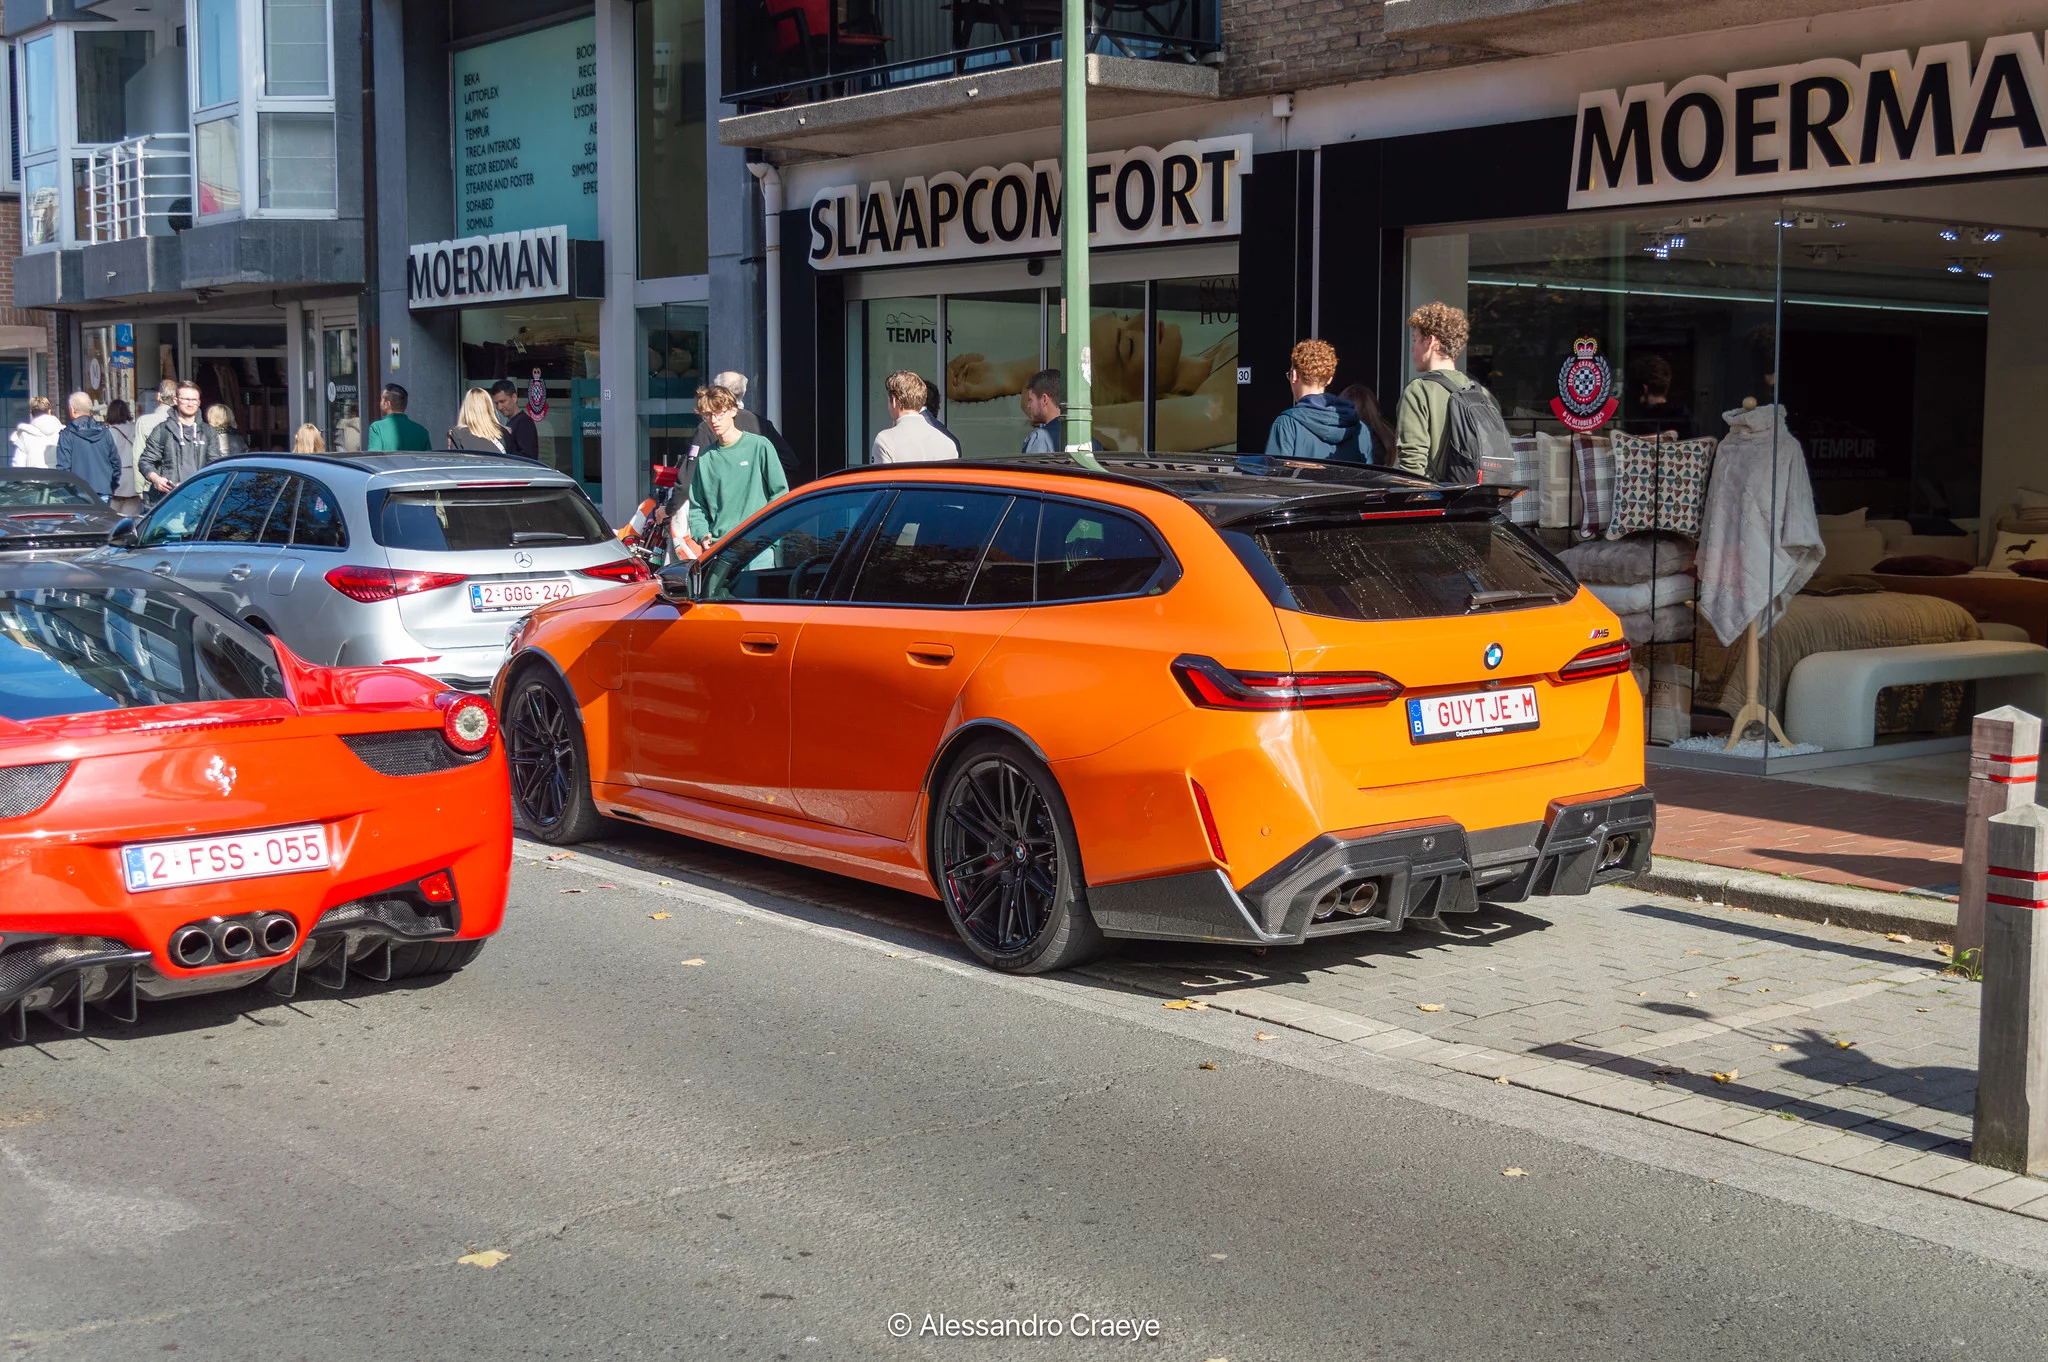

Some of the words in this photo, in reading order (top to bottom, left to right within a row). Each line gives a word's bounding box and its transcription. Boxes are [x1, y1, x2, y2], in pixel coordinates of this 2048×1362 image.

[464, 73, 480, 87] BEKA
[464, 87, 499, 105] LATTOFLEX
[464, 107, 489, 123] AUPING
[1576, 53, 2048, 192] MOERMA
[465, 125, 490, 141] TEMPUR
[465, 142, 486, 159] TRECA
[487, 138, 521, 155] INTERIORS
[465, 162, 487, 177] RECOR
[488, 157, 518, 174] BEDDING
[465, 178, 493, 195] STEARNS
[493, 176, 509, 190] AND
[510, 173, 534, 188] FOSTER
[466, 198, 494, 213] SOFABED
[810, 148, 1238, 261] SLAAPCOMFORT
[466, 216, 493, 231] SOMNUS
[407, 235, 558, 300] MOERMAN
[1238, 370, 1250, 381] 30
[1810, 438, 1876, 459] TEMPUR
[1414, 720, 1423, 732] B
[133, 870, 146, 885] B
